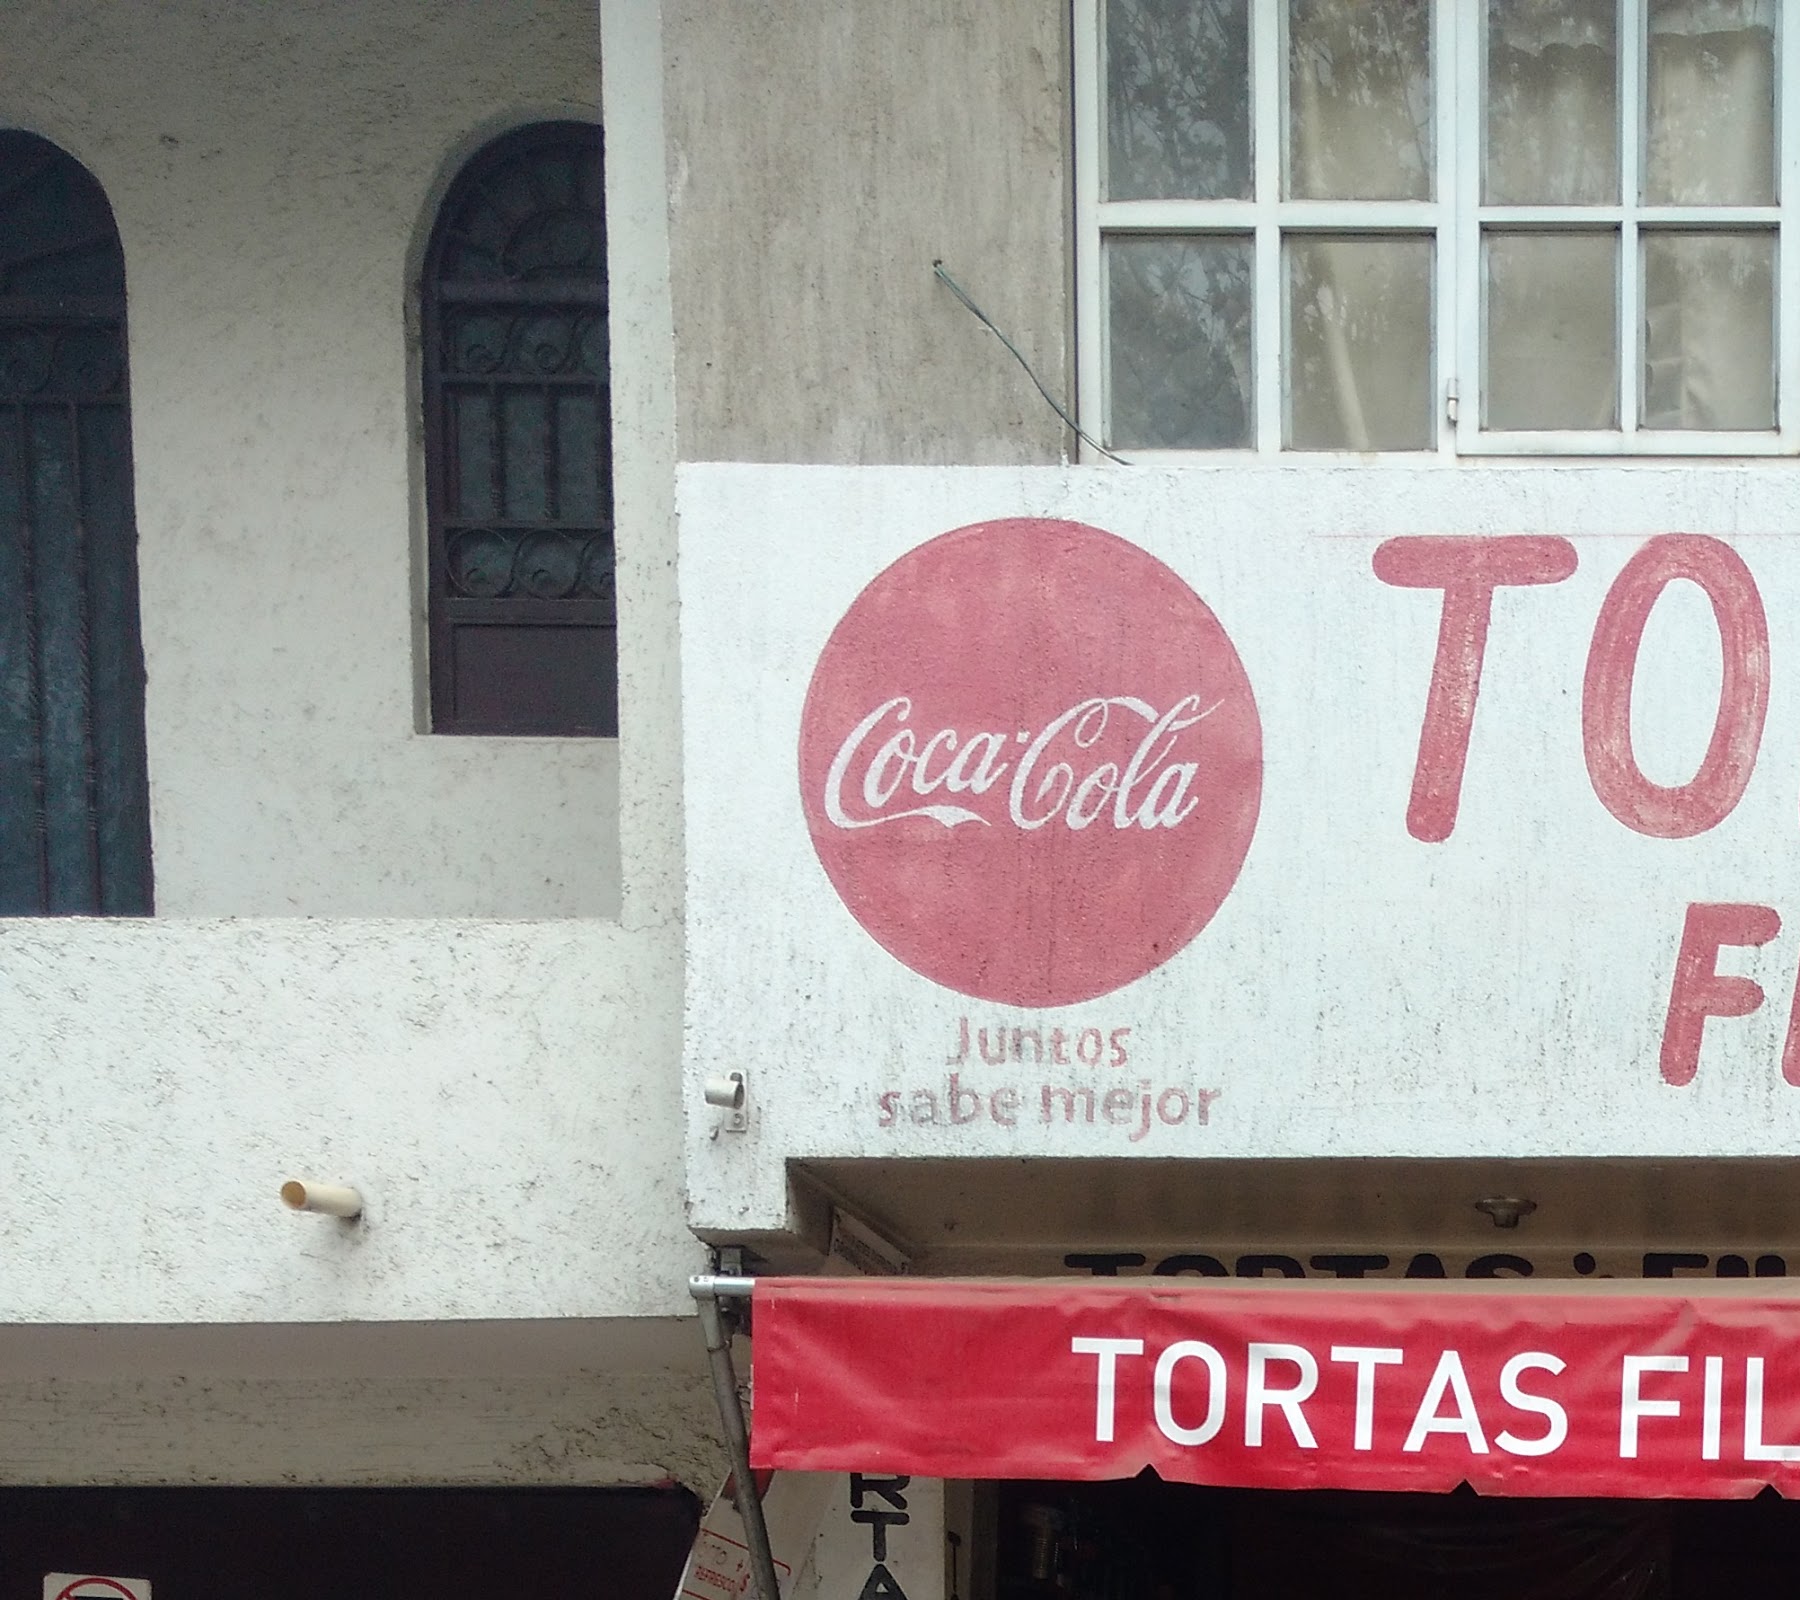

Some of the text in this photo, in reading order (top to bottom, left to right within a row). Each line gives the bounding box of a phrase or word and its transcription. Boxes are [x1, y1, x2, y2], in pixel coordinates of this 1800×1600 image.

[824, 695, 1226, 831] Coca-Cola
[956, 1017, 1130, 1068] Juntos
[877, 1073, 1224, 1142] sabe mejor
[1071, 1336, 1569, 1458] TORTAS
